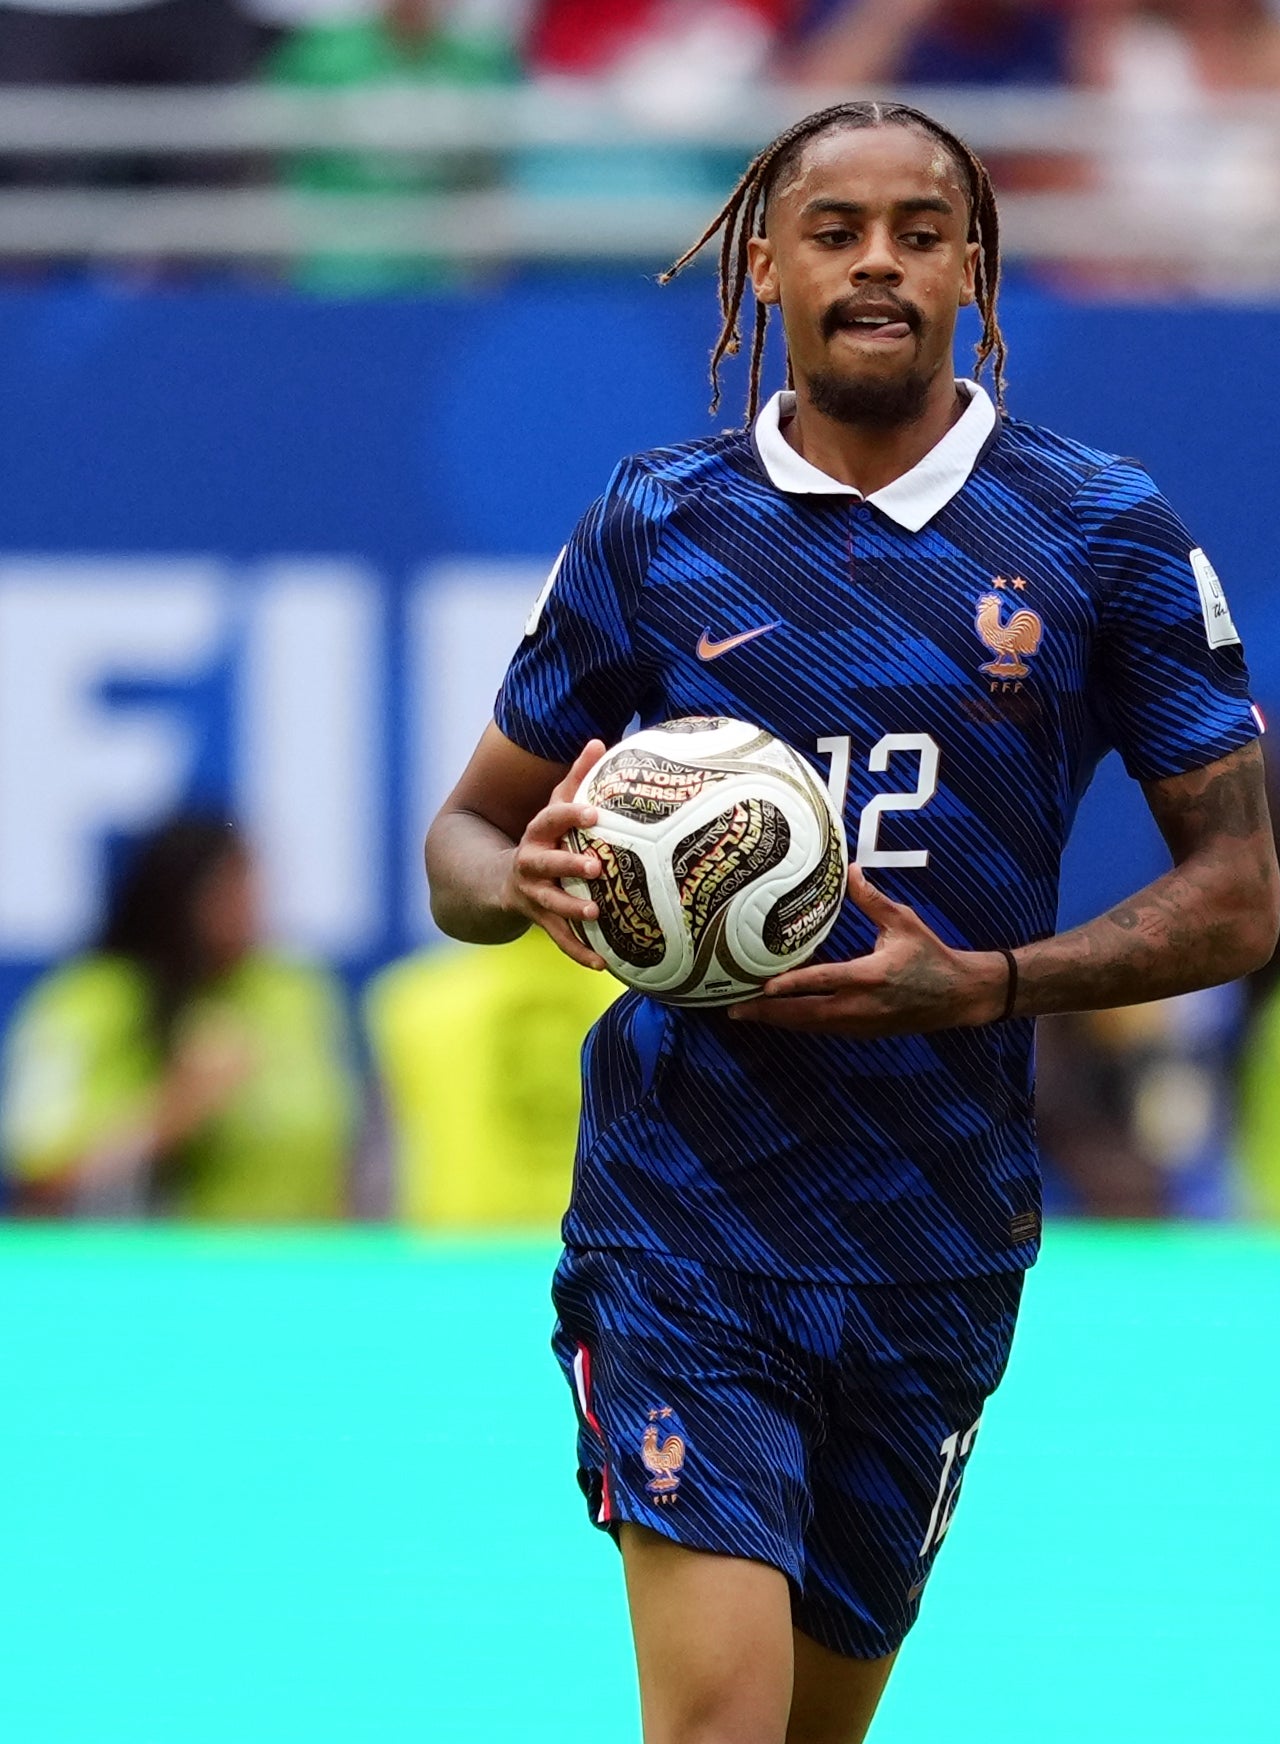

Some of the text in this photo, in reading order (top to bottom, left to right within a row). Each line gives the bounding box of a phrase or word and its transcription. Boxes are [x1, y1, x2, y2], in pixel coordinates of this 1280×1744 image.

[989, 680, 1023, 693] FFF
[629, 783, 700, 799] JERSEY
[642, 769, 702, 786] YORK
[816, 732, 939, 868] 12
[681, 803, 747, 904] ATLANTA
[695, 812, 763, 918] NEW JERSEY
[590, 838, 660, 937] MIAMI
[782, 901, 823, 937] FINAL
